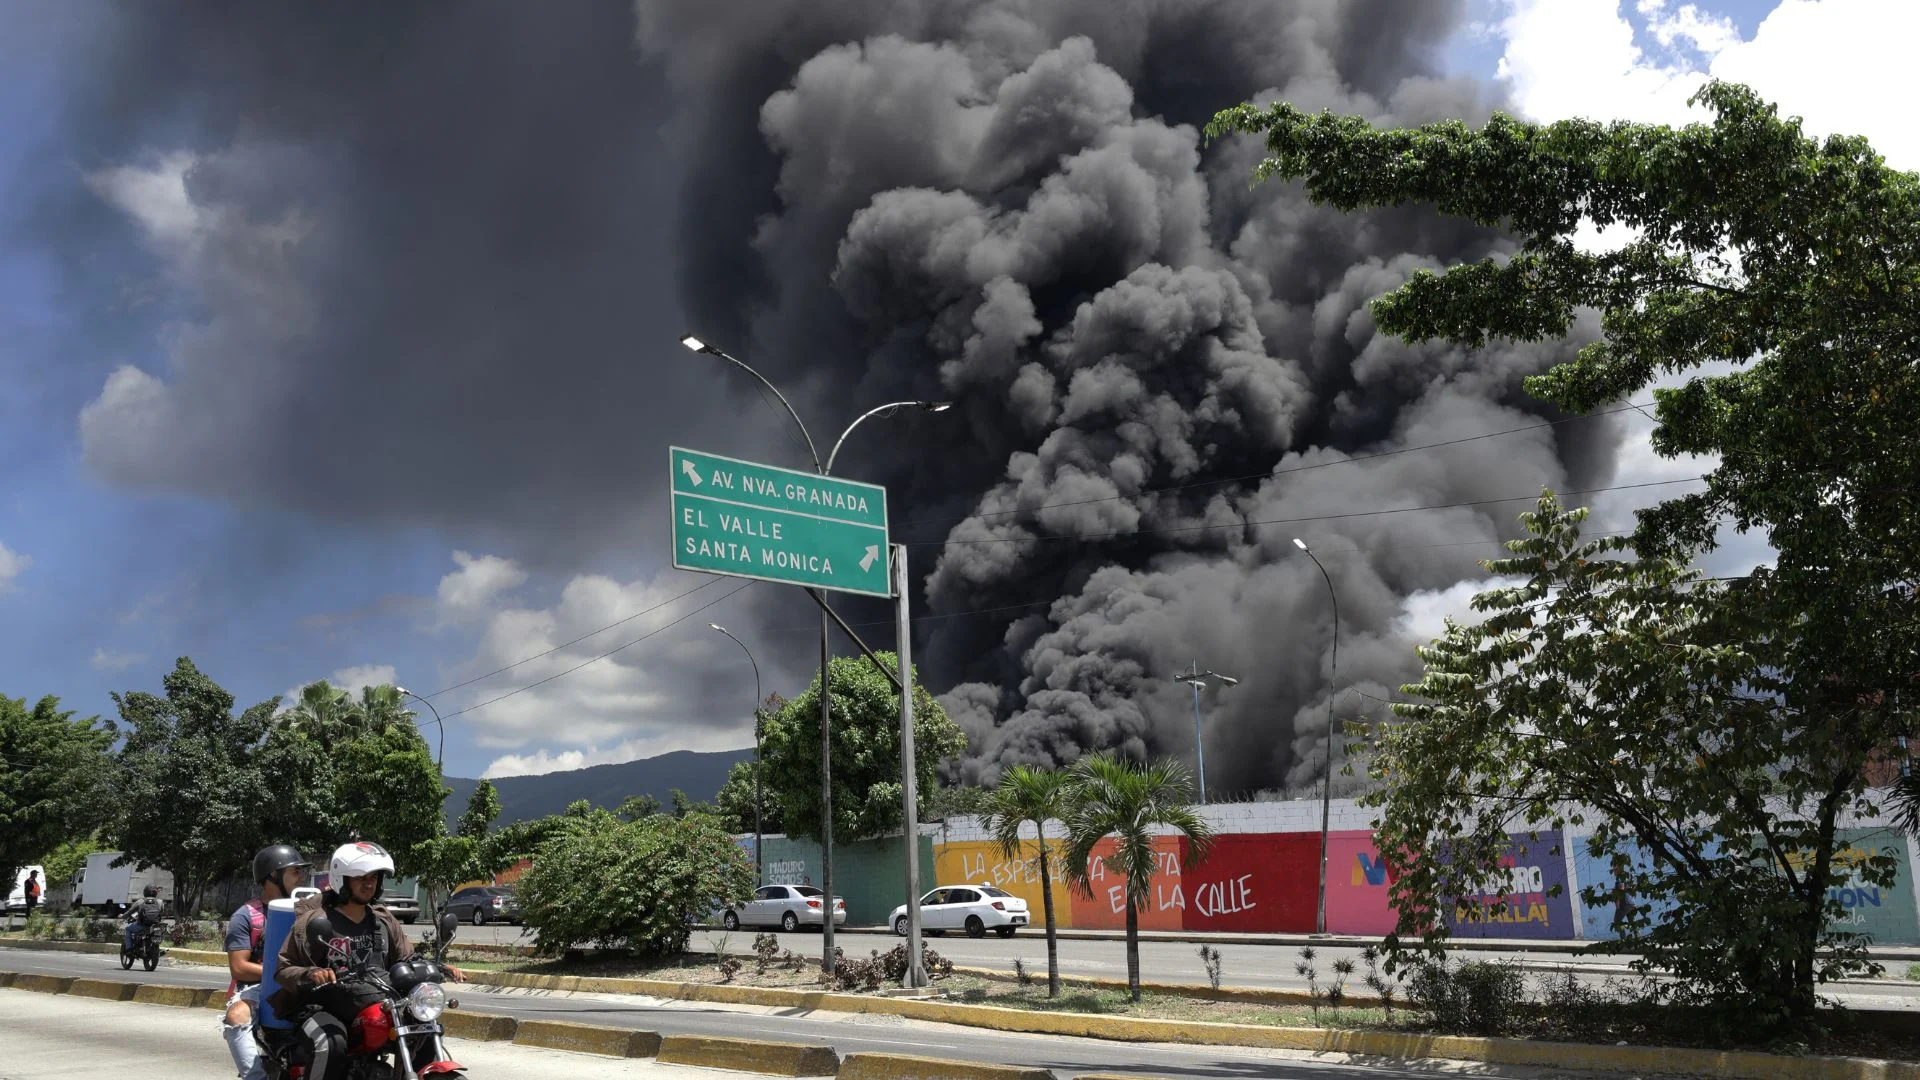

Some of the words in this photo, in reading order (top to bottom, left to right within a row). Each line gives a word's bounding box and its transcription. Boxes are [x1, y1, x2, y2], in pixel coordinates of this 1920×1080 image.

[711, 470, 734, 490] AV.
[742, 475, 781, 498] NVA.
[785, 484, 868, 513] GRANADA
[683, 508, 709, 528] EL
[719, 513, 783, 540] VALLE
[686, 537, 752, 563] SANTA
[762, 549, 833, 575] MONICA
[769, 860, 805, 874] MADURO
[769, 873, 804, 885] SOMOS
[962, 852, 986, 881] LA
[991, 856, 1105, 886] ESPEAA
[1158, 884, 1187, 912] LA
[1195, 873, 1257, 917] CALLE
